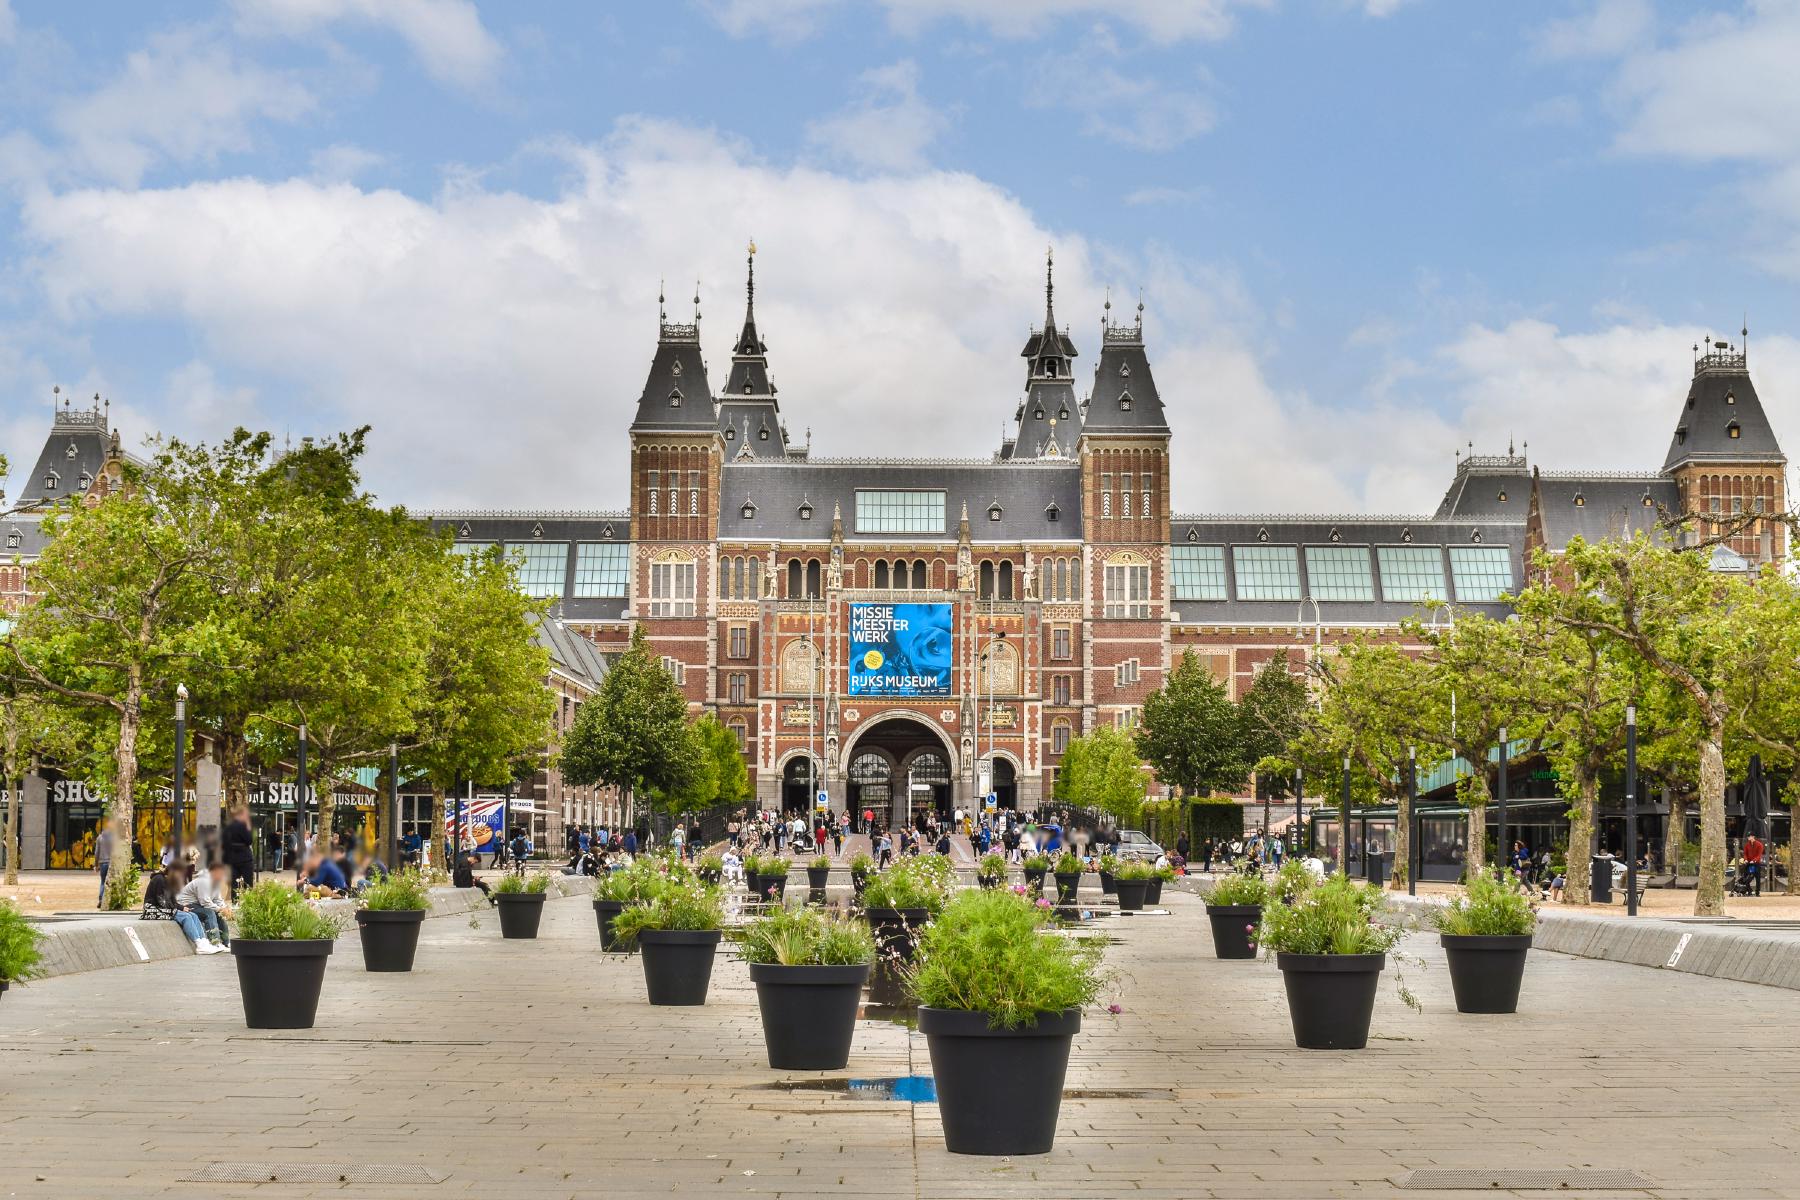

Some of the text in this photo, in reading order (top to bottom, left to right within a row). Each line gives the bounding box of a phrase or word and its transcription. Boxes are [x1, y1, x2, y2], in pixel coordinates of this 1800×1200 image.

[853, 607, 893, 618] MISSIE
[853, 619, 908, 630] MEESTER
[853, 631, 888, 642] WERK
[852, 675, 937, 687] RIJKS MUSEUM
[53, 780, 108, 802] SHO
[149, 789, 197, 802] USEM
